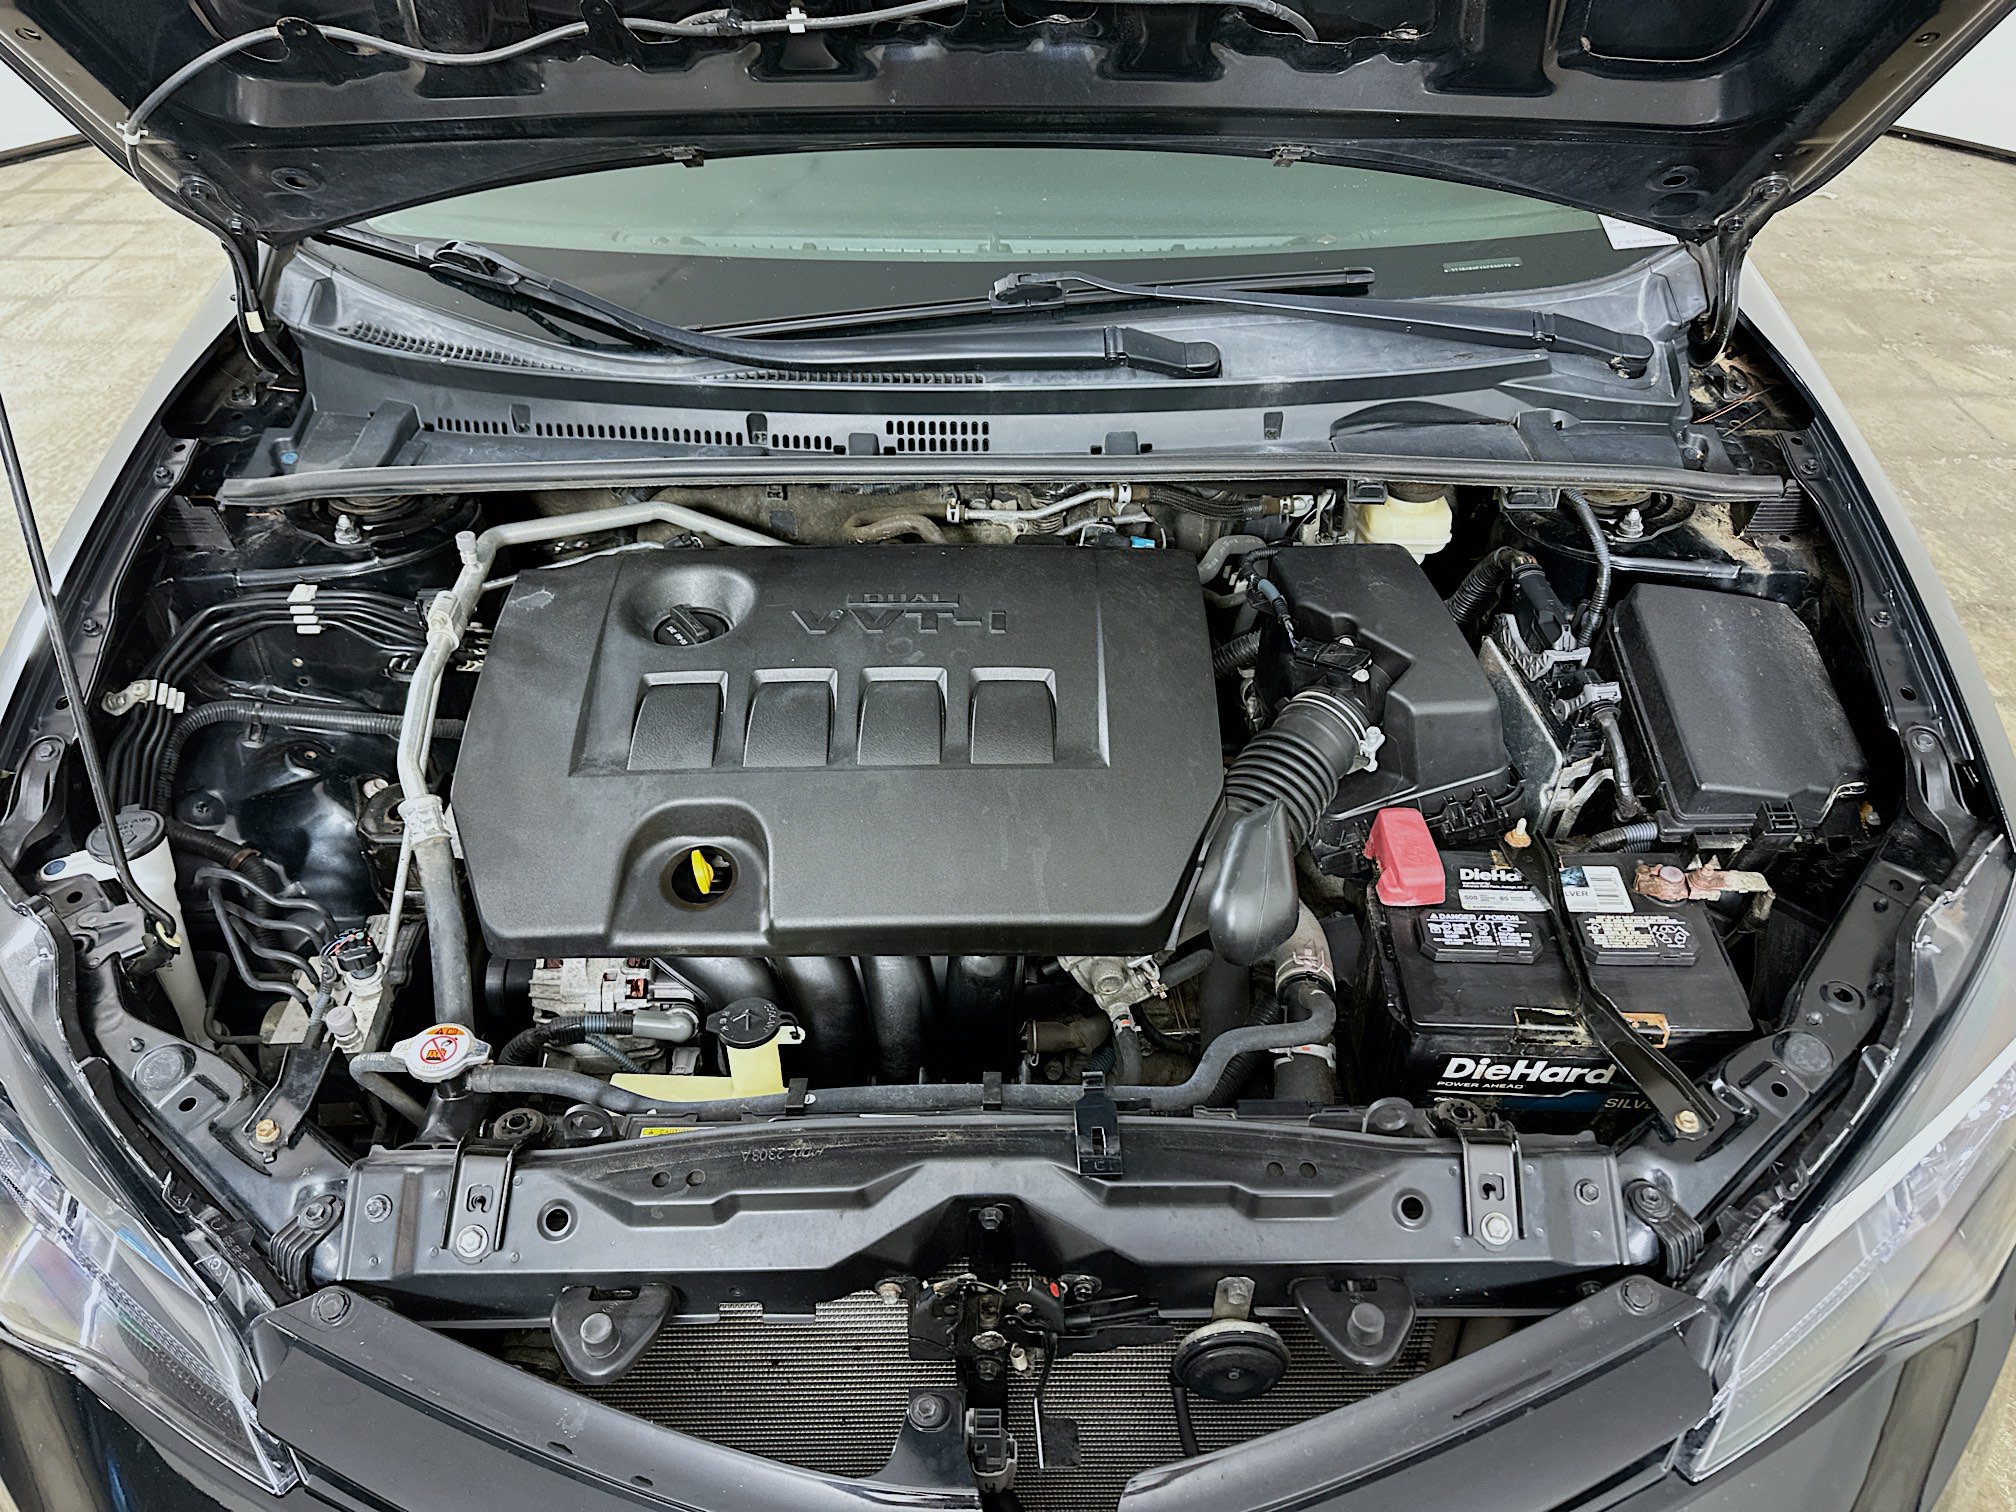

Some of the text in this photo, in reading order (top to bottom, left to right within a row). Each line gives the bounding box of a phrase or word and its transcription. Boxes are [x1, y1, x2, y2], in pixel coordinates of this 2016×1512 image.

[863, 593, 949, 603] DUAL
[1459, 868, 1523, 881] DieHa
[1442, 1057, 1619, 1085] DieHard
[1604, 1098, 1651, 1109] SILV
